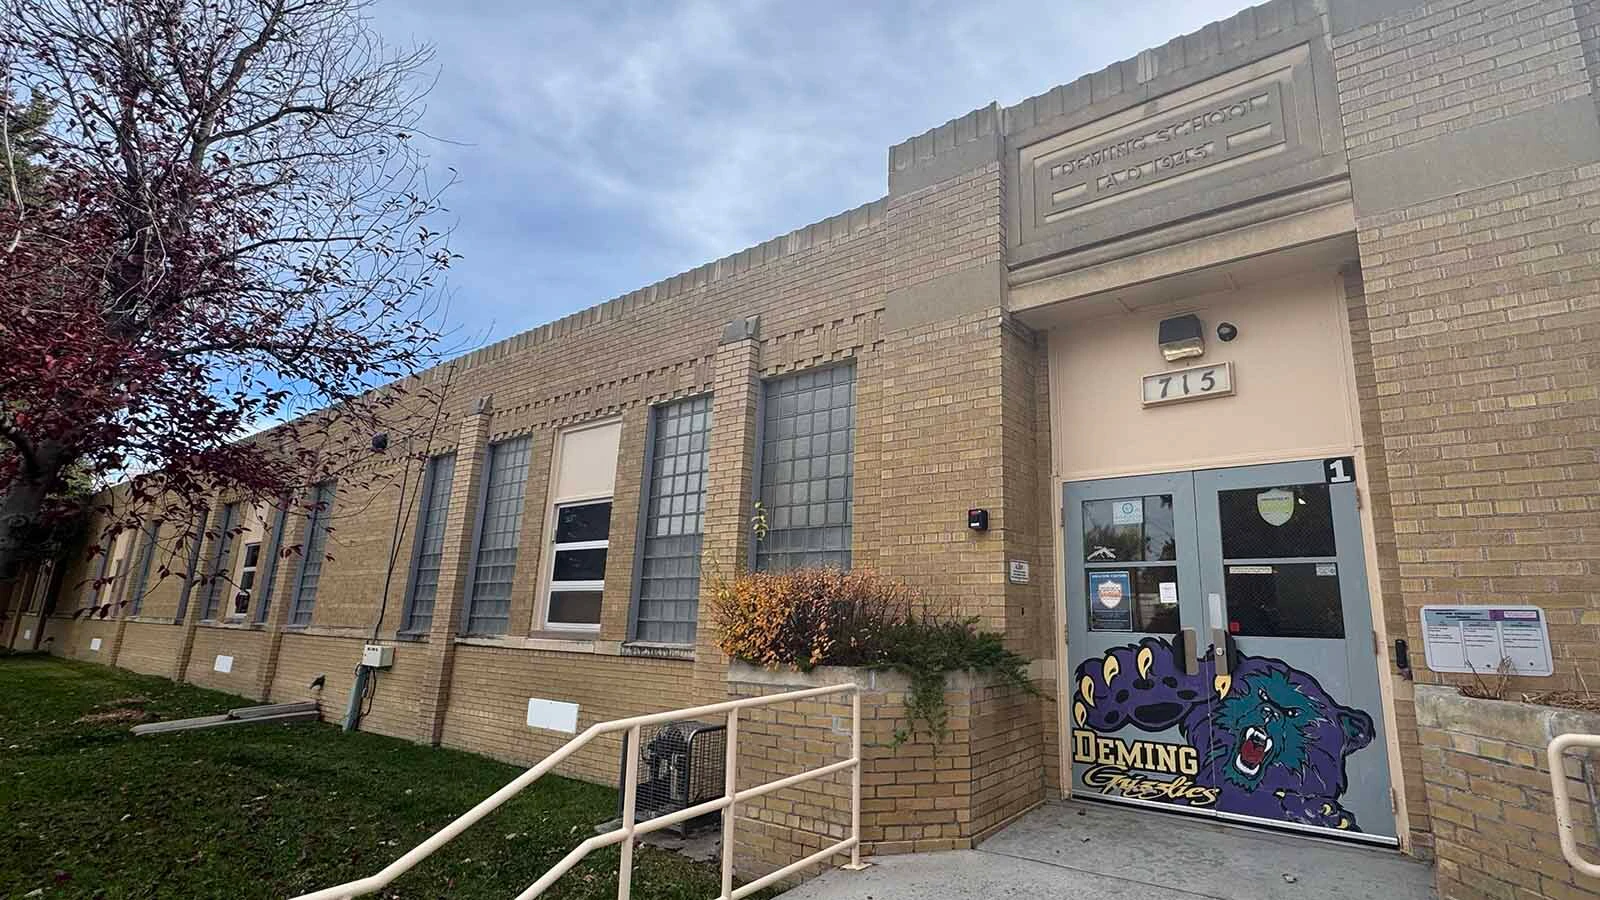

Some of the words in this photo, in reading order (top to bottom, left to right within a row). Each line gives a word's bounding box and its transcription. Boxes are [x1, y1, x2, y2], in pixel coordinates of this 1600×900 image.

[1062, 138, 1146, 177] DEMING
[1156, 100, 1257, 141] SCHOOL
[1152, 147, 1208, 176] 1945
[1159, 370, 1215, 398] 715
[1329, 460, 1351, 483] 1
[1072, 729, 1199, 776] DEMING
[1083, 764, 1220, 806] Grizzlies
